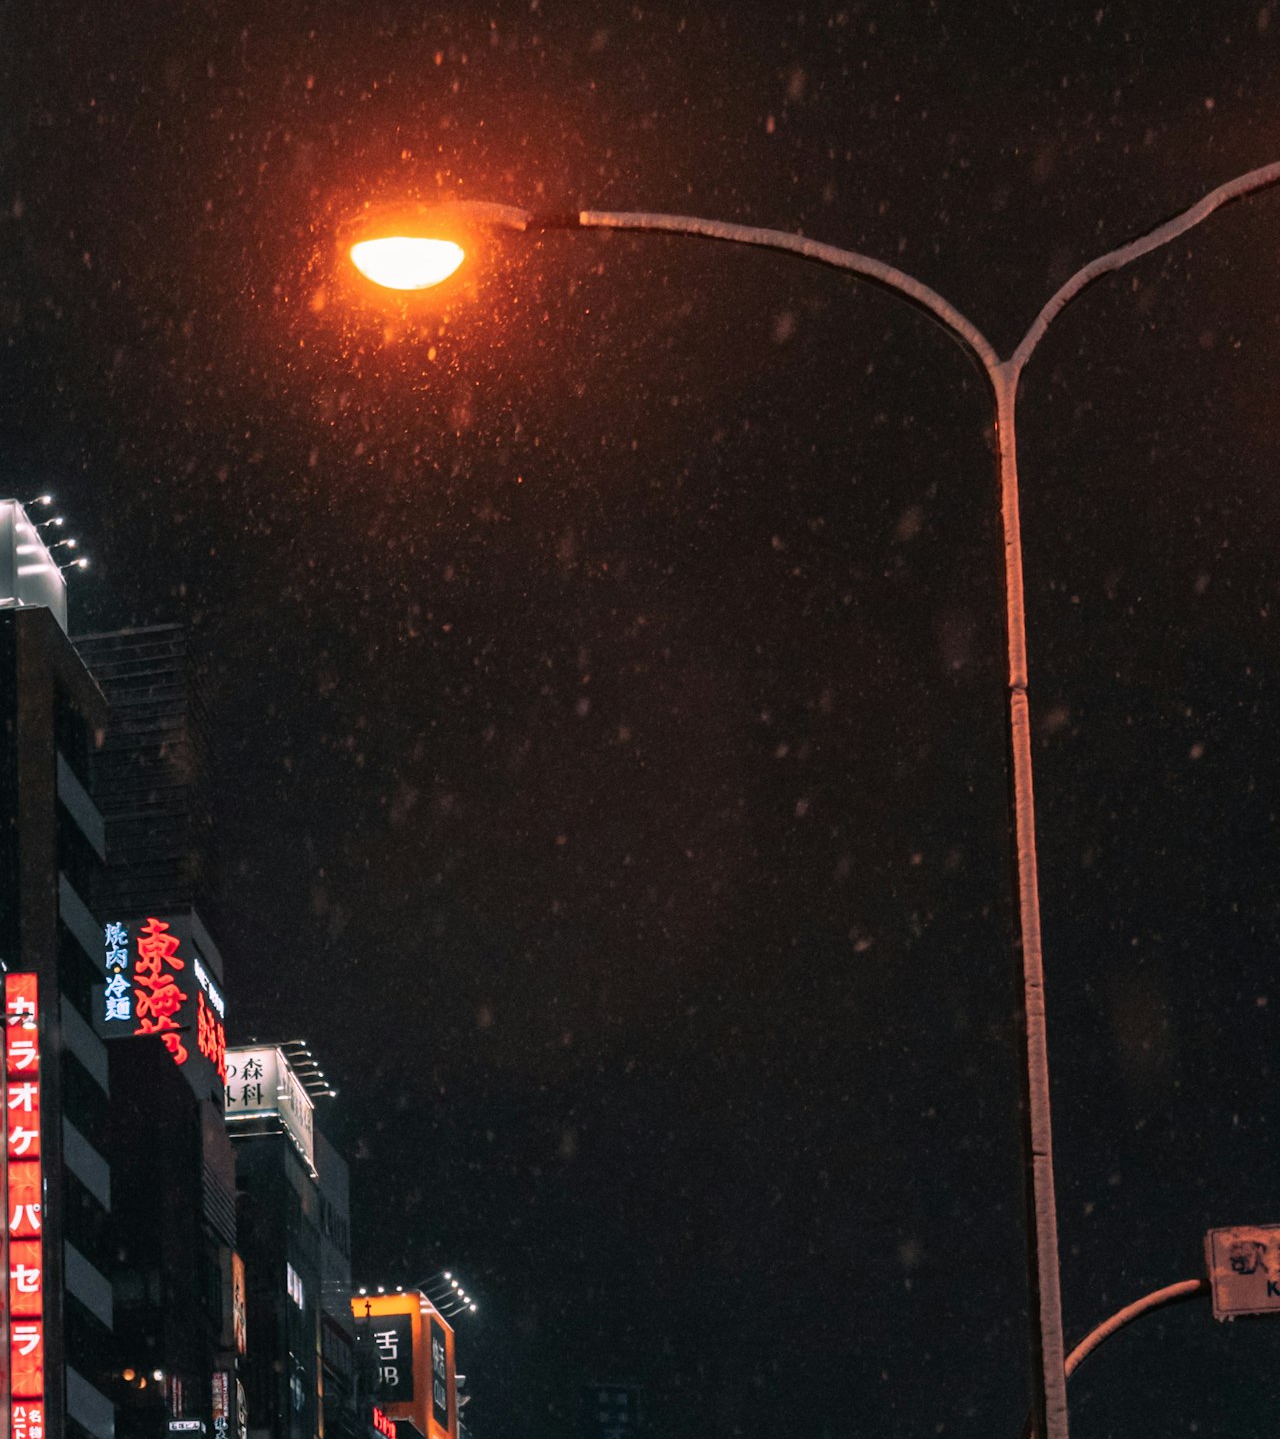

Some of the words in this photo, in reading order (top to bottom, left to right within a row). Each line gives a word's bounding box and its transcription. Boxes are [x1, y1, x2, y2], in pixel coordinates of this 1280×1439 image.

[7, 996, 41, 1356] カラオケパセラ
